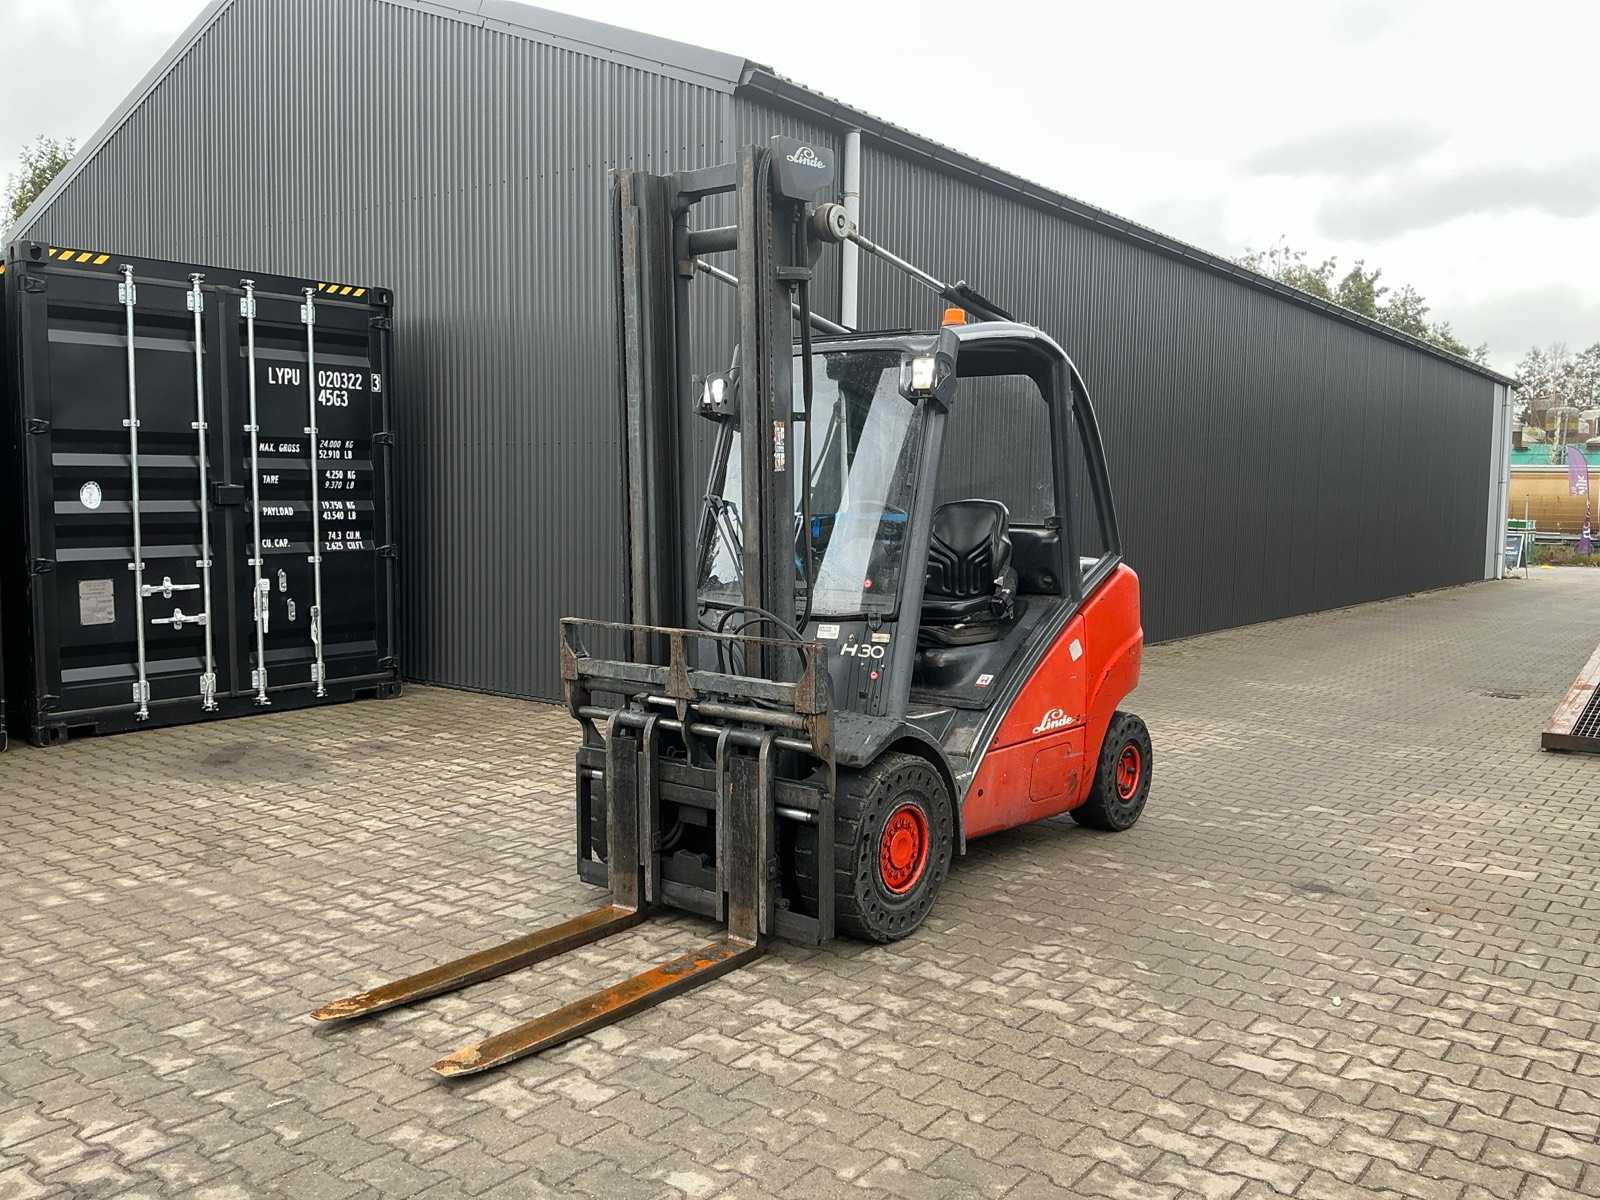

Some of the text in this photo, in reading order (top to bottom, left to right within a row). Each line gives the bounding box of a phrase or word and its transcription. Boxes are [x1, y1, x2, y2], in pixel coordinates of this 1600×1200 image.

[786, 146, 826, 168] Linde
[268, 366, 300, 385] LYPU
[318, 370, 362, 390] 020322
[318, 389, 348, 407] 45G3
[259, 442, 300, 453] MAX. GROSS
[319, 440, 354, 448] 24.000 KG
[319, 450, 353, 459] 52.910 LB
[325, 470, 356, 479] 4.250 KG
[262, 475, 279, 484] TARE
[324, 481, 354, 489] 9.370 LB
[346, 501, 355, 509] KG
[262, 506, 294, 516] PAYLOAD
[323, 511, 357, 520] 43.540 LB
[328, 531, 342, 540] 74.3
[1032, 708, 1073, 734] Linde
